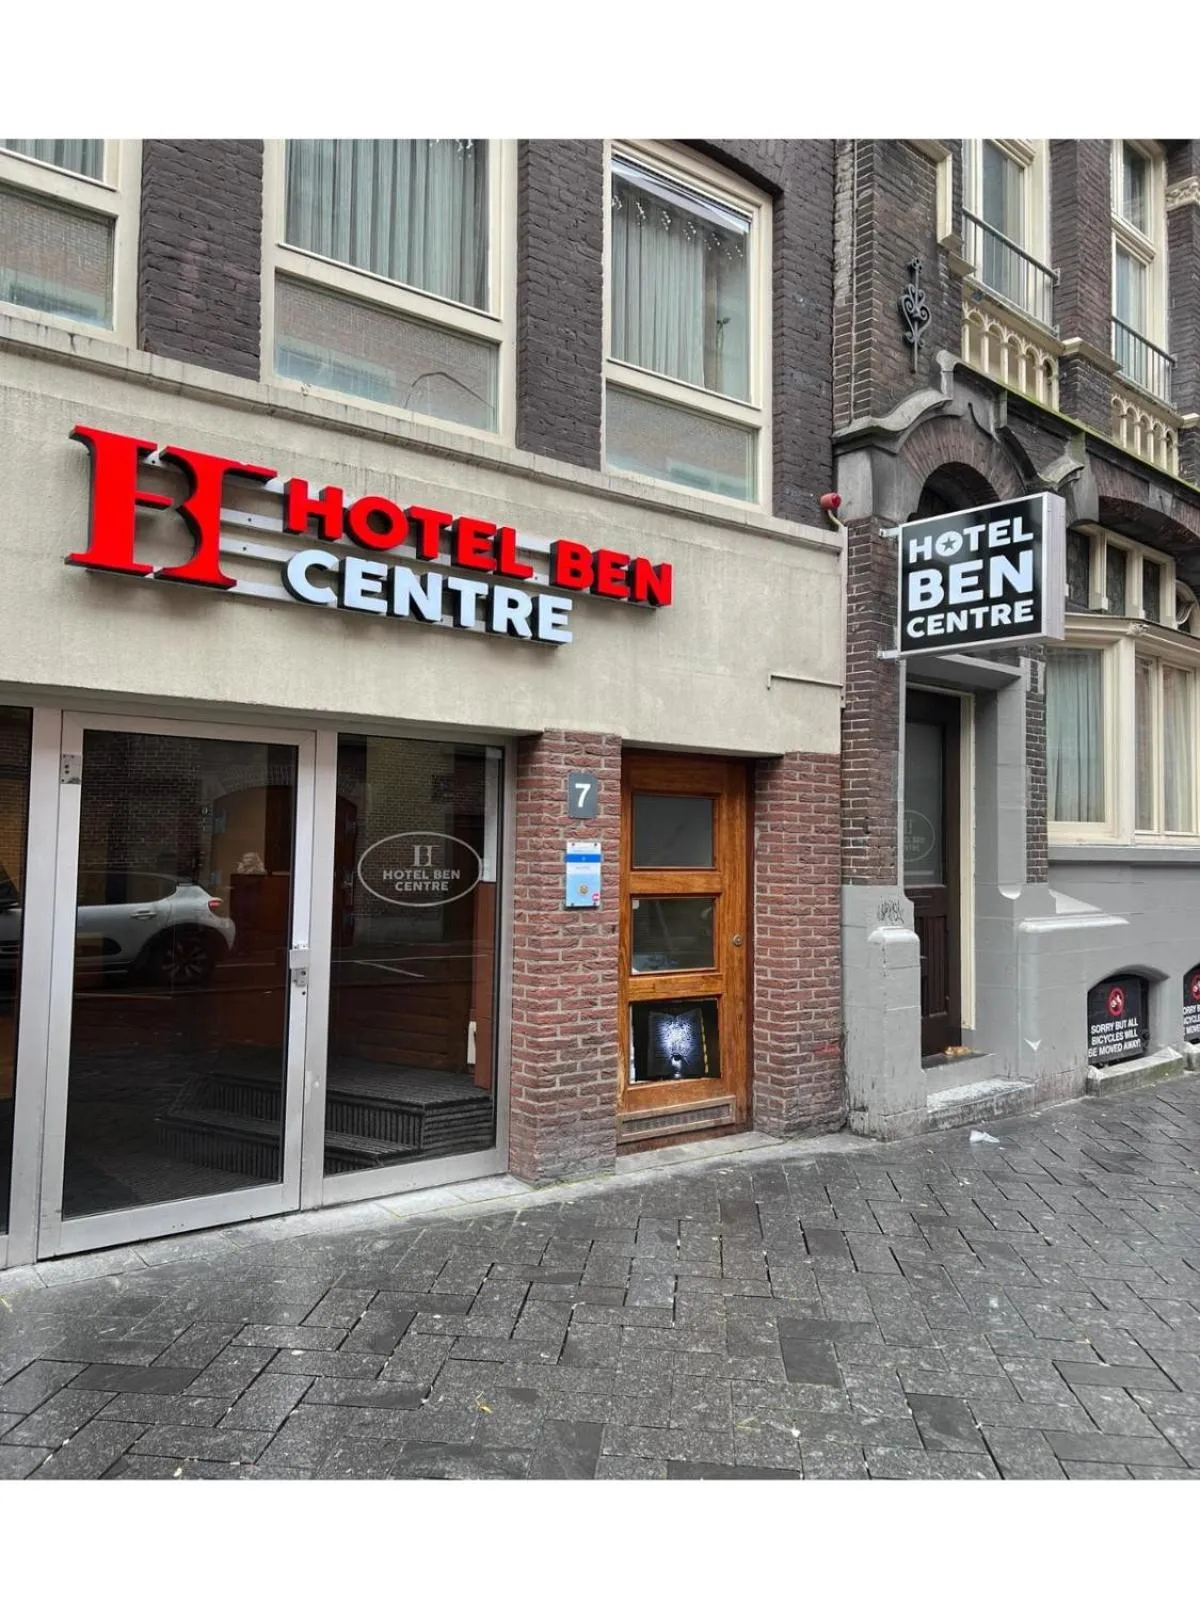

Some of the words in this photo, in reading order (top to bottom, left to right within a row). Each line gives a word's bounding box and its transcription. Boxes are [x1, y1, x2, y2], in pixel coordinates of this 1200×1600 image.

[284, 477, 534, 580] HOTEL
[551, 539, 672, 607] BEN
[909, 516, 1033, 563] HOTEL
[908, 550, 1033, 612] BEN
[283, 549, 573, 644] CENTRE
[906, 600, 1034, 638] CENTRE
[575, 783, 591, 808] 7
[382, 869, 429, 880] HOTEL
[433, 869, 460, 880] BEN
[394, 881, 449, 892] CENTRE
[1091, 1022, 1114, 1034] SORRY
[1115, 1020, 1127, 1030] BUT
[1127, 1017, 1138, 1027] ALL
[1091, 1031, 1124, 1046] BICYCLES
[1124, 1028, 1138, 1039] WILL
[1088, 1047, 1098, 1057] BE
[1099, 1043, 1122, 1055] MOVED
